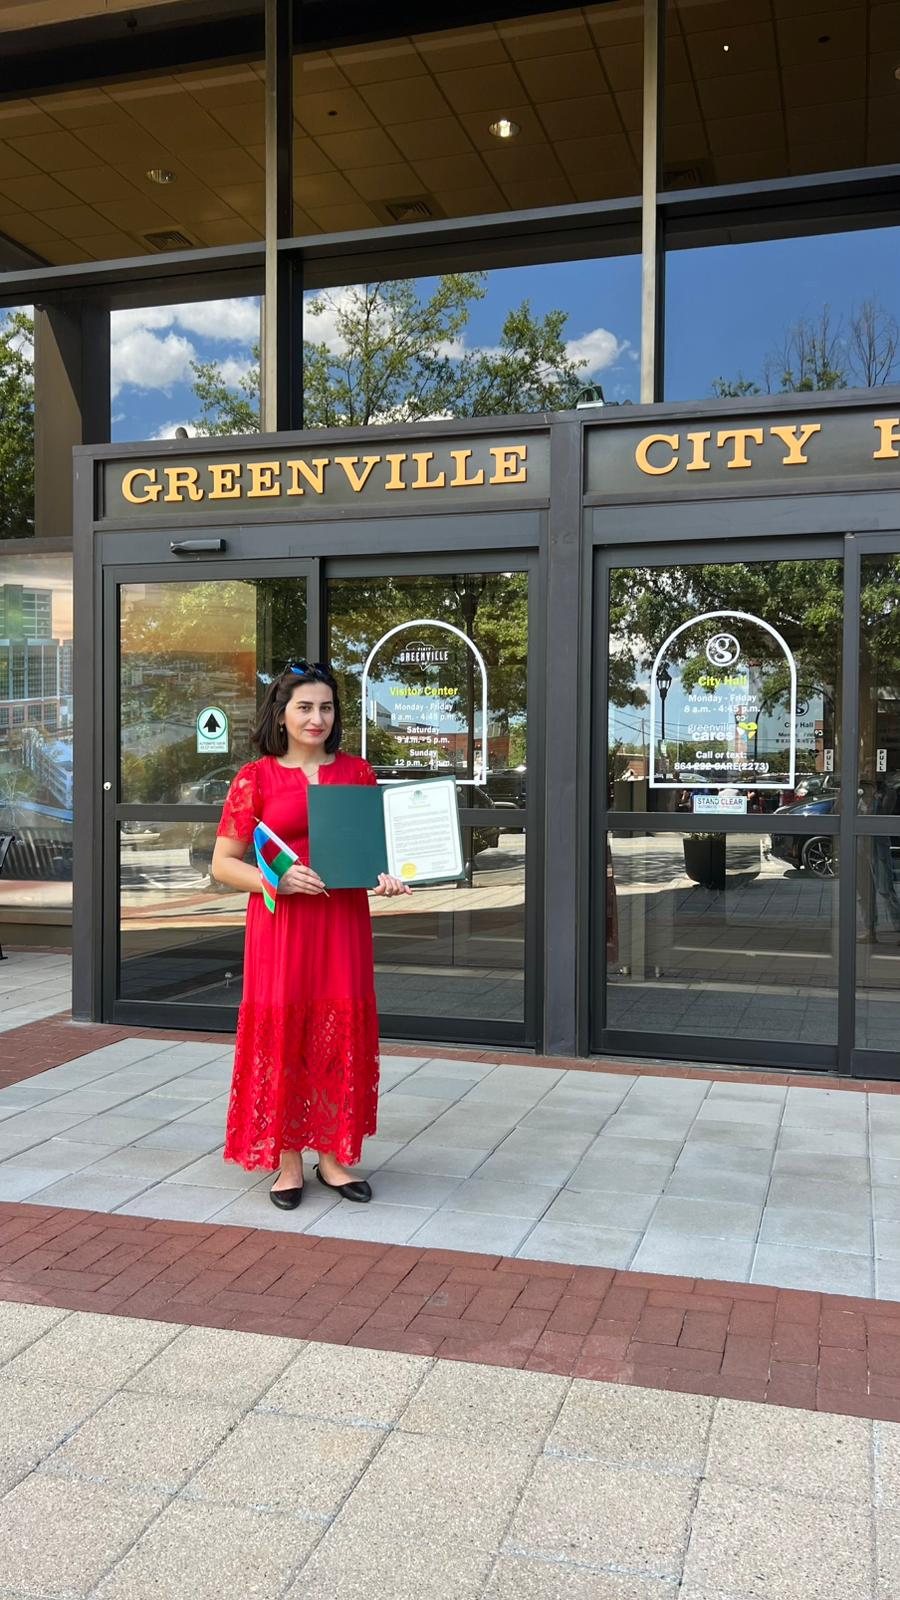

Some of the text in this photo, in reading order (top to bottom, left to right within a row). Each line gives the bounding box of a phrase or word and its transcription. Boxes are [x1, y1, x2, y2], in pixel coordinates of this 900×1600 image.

[635, 423, 821, 475] CITY
[121, 445, 528, 504] GREENVILLE
[400, 651, 449, 662] GREENVILLE
[698, 675, 747, 688] City Hall
[389, 686, 458, 696] Visitor Center
[688, 694, 722, 704] Monday
[730, 694, 757, 703] Friday
[394, 703, 424, 712] Monday
[430, 703, 454, 712] Friday
[407, 726, 440, 735] Saturday
[692, 732, 735, 741] cares
[410, 749, 437, 758] Sunday
